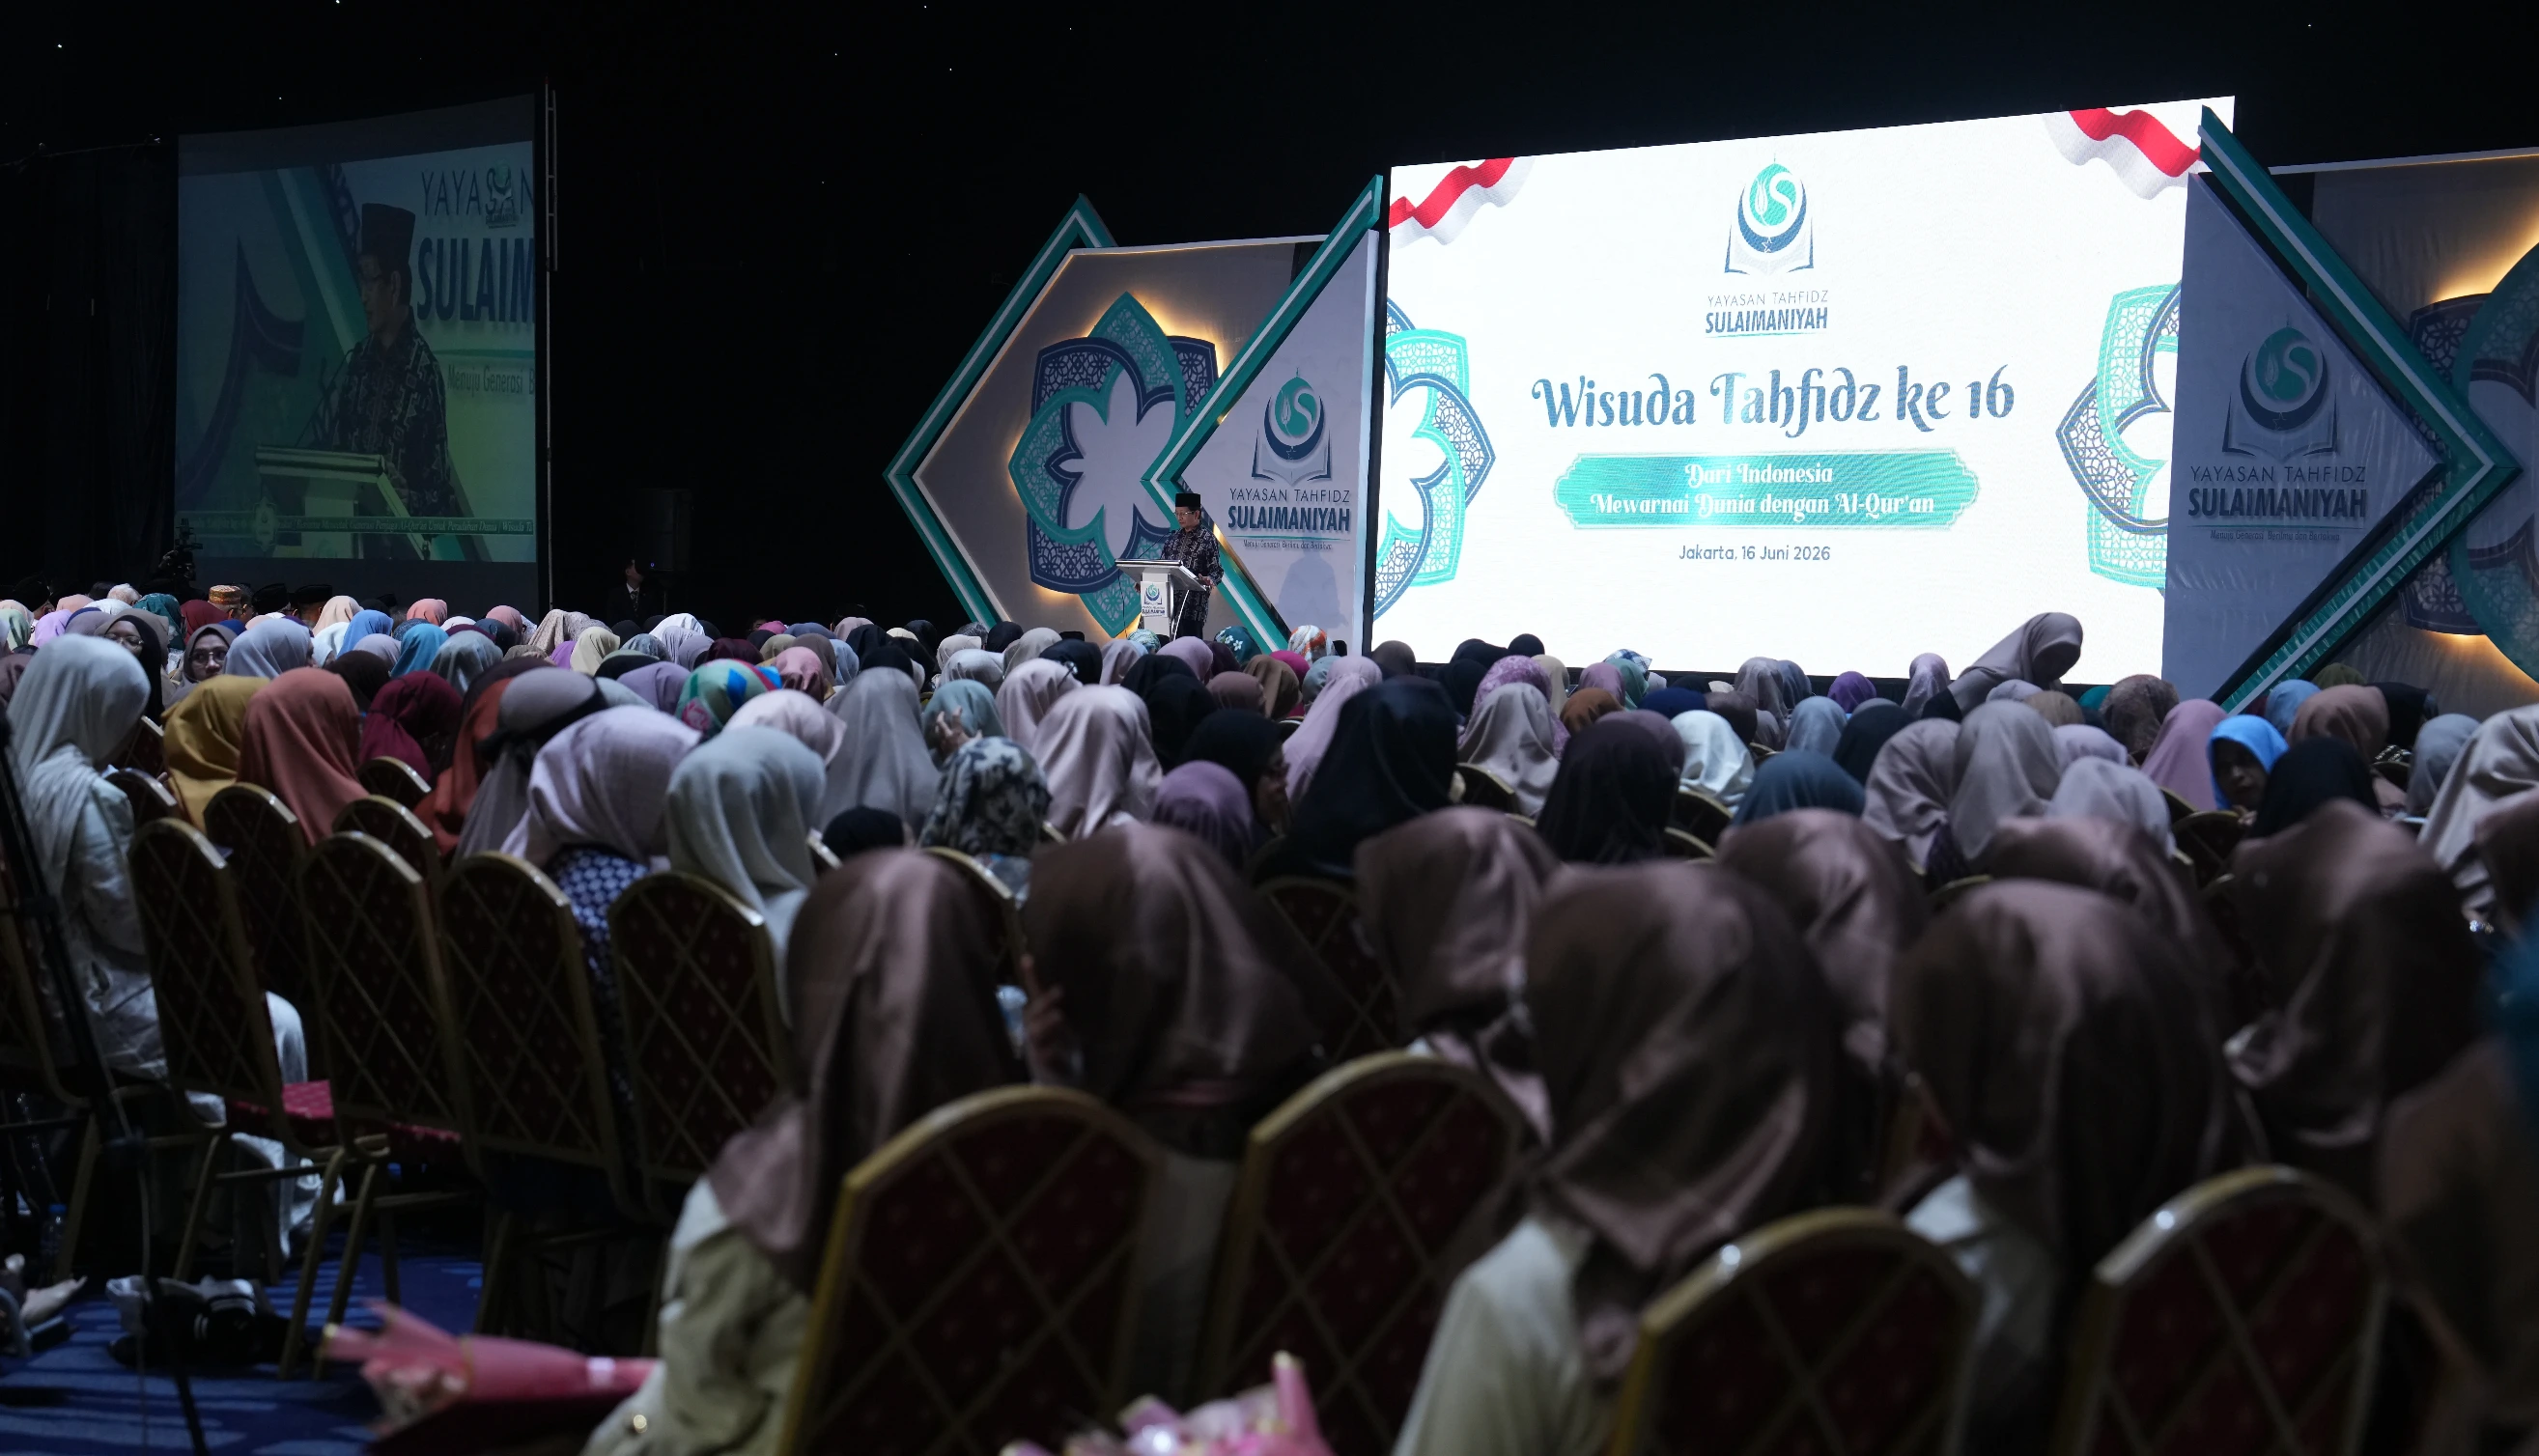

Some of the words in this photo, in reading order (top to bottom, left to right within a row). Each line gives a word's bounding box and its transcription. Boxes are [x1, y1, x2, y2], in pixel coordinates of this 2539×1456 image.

[1707, 294, 1765, 307] YAYASAN
[1773, 290, 1828, 304] TAHFIDZ
[1706, 307, 1828, 333] SULAIMANIYAH
[1532, 373, 1696, 428] Wisuda
[1709, 368, 1880, 438] Tahfidz
[1896, 365, 1951, 433] ke
[1965, 364, 2015, 419] 16
[1684, 463, 1732, 489] Dari
[1736, 462, 1833, 484] Indonesia
[2190, 465, 2274, 482] YAYASAN
[2284, 466, 2366, 483] TAHFIDZ
[1229, 488, 1287, 501] YAYASAN
[1294, 489, 1350, 503] TAHFIDZ
[1591, 493, 1689, 515] Mewarnai
[1695, 493, 1756, 518] Dunia
[1760, 493, 1829, 522] dengan
[1834, 492, 1934, 518] Al-Qur'an
[2188, 488, 2367, 518] SULAIMANIYAH
[1227, 505, 1350, 531] SULAIMANIYAH
[2210, 530, 2234, 541] Menuju
[2236, 530, 2265, 540] Generasi
[2268, 530, 2293, 540] Berilmu
[2295, 531, 2307, 541] dan
[1679, 545, 1738, 562] Jakarta,
[1742, 546, 1756, 560] 16
[1760, 545, 1790, 561] Juni
[1793, 546, 1831, 561] 2026
